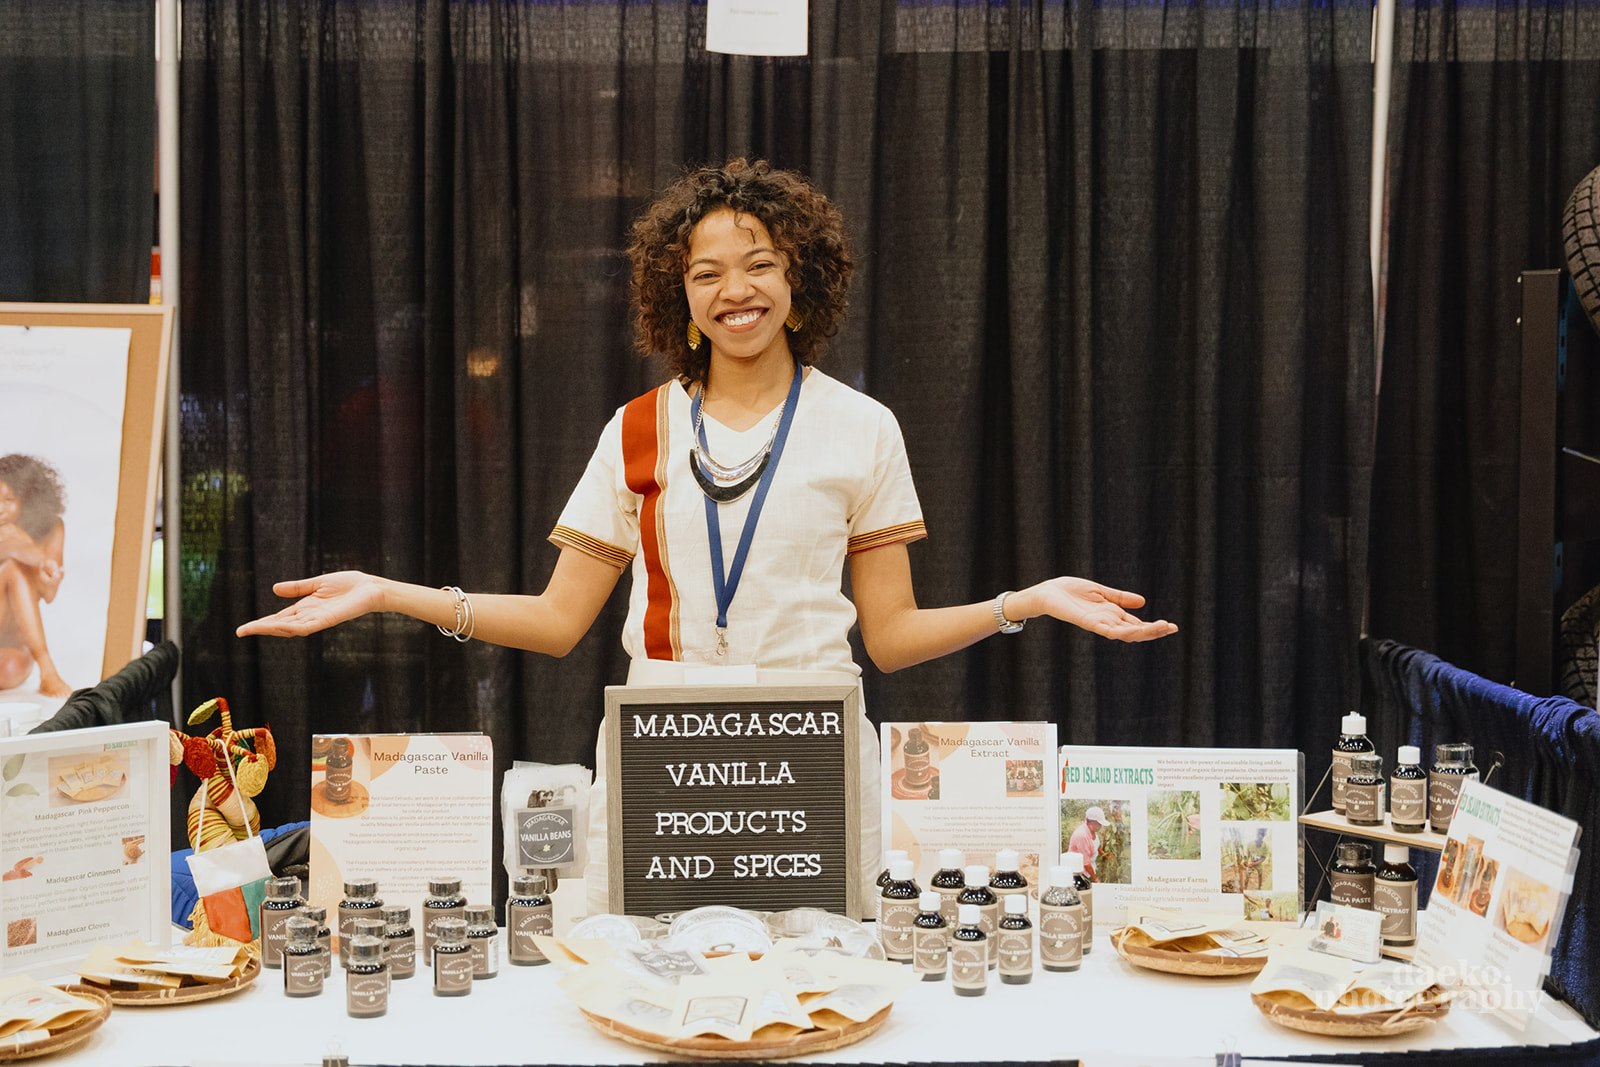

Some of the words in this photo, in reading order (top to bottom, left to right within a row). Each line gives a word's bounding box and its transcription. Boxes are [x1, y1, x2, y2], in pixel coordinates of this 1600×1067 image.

[633, 711, 841, 738] MADAGASCAR
[940, 738, 1003, 748] Madagascar
[1007, 738, 1040, 746] Vanilla
[373, 752, 447, 764] Madagascar
[451, 751, 489, 761] Vanilla
[971, 749, 1009, 758] Extract
[414, 766, 449, 775] Paste
[665, 762, 796, 786] VANILLA
[1064, 767, 1080, 783] RED
[1083, 766, 1111, 783] ISLAND
[1114, 767, 1154, 785] EXTRACTS
[35, 811, 75, 820] Madagascar
[526, 814, 565, 829] MADAGASCAR
[655, 811, 807, 835] PRODUCTS
[520, 832, 549, 842] VANILLA
[550, 830, 572, 840] BEANS
[645, 856, 715, 879] AND
[733, 854, 822, 878] SPICES
[46, 873, 86, 884] Madagascar
[87, 868, 121, 878] Cinnamon
[1147, 876, 1186, 884] Madagascar
[46, 926, 86, 938] Madagascar
[88, 922, 110, 930] Cloves
